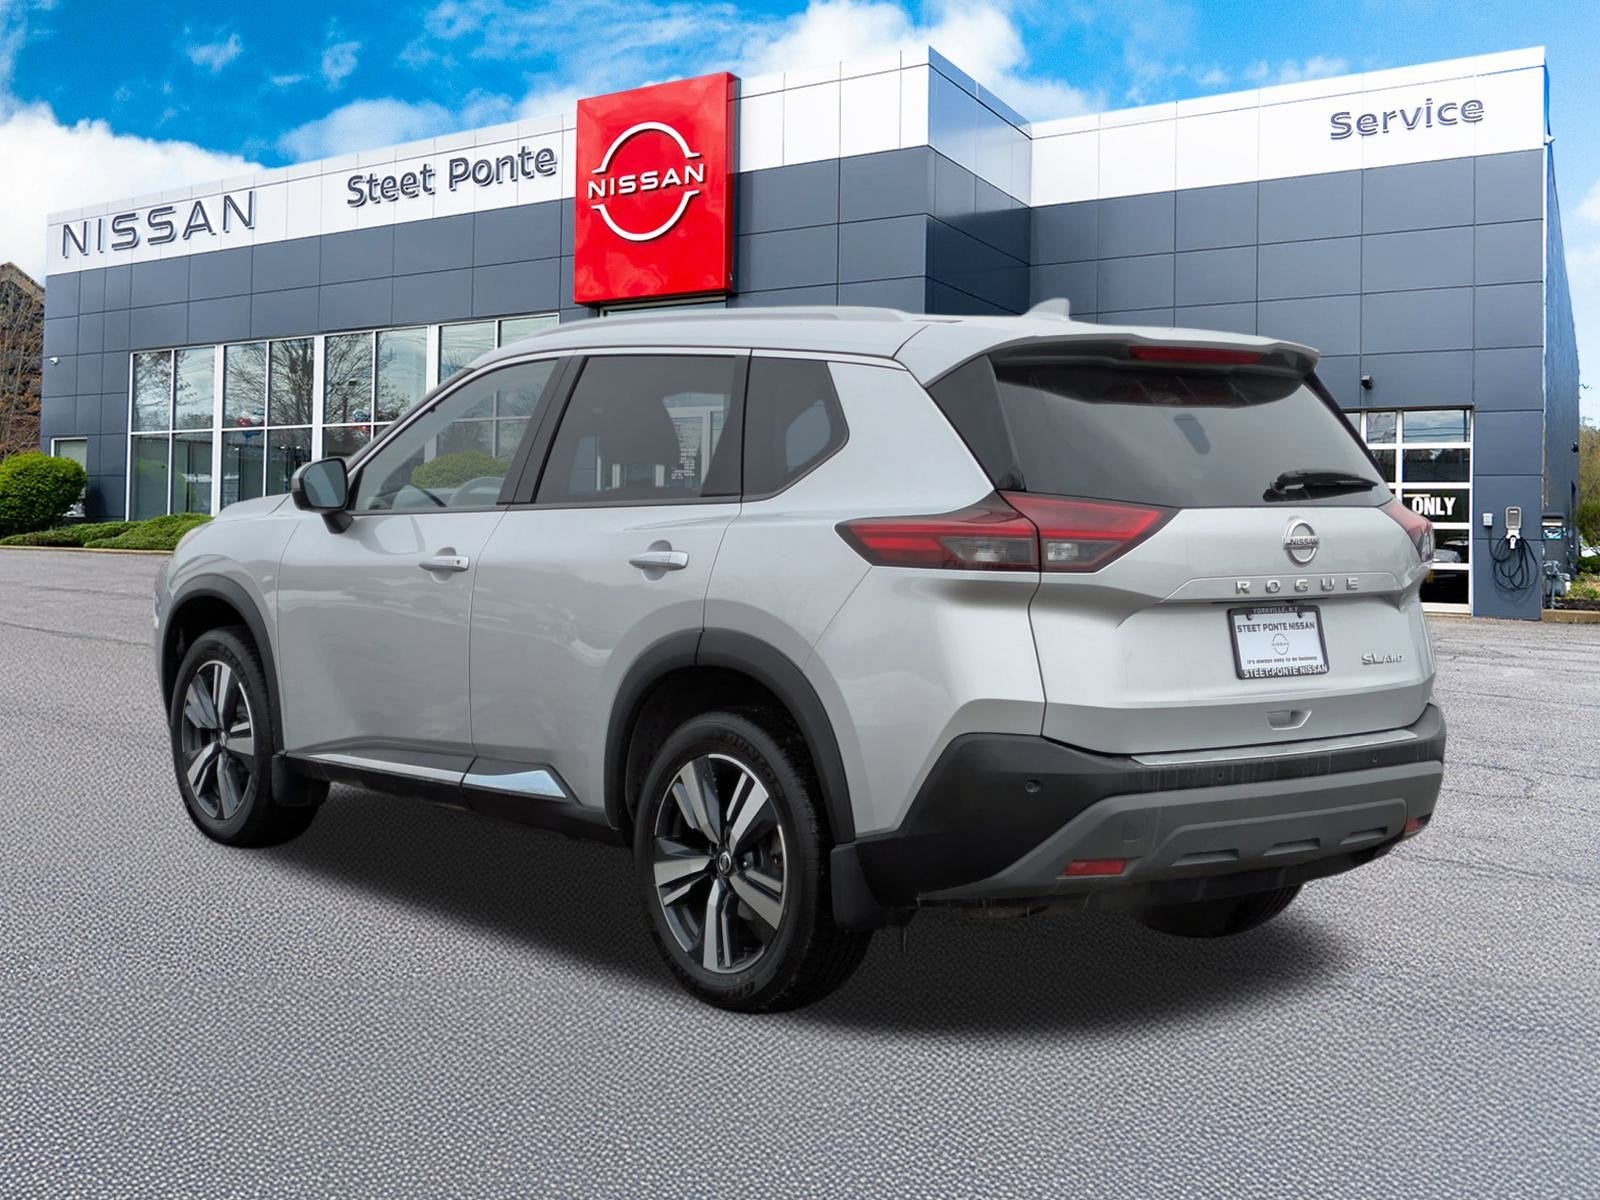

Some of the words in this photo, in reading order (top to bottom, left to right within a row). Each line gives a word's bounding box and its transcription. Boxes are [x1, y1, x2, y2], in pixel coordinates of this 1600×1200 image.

[1330, 98, 1484, 140] Service
[346, 162, 435, 208] Steet
[448, 144, 557, 191] Ponte
[587, 163, 705, 200] NISSAN
[62, 190, 255, 259] NISSAN
[1411, 496, 1456, 516] ONLY
[1235, 577, 1360, 595] ROGUE
[1237, 624, 1261, 633] STEET
[1262, 622, 1288, 632] PONTE
[1288, 621, 1315, 631] NISSAN
[1299, 664, 1328, 675] NISSAN
[1361, 653, 1383, 666] SL
